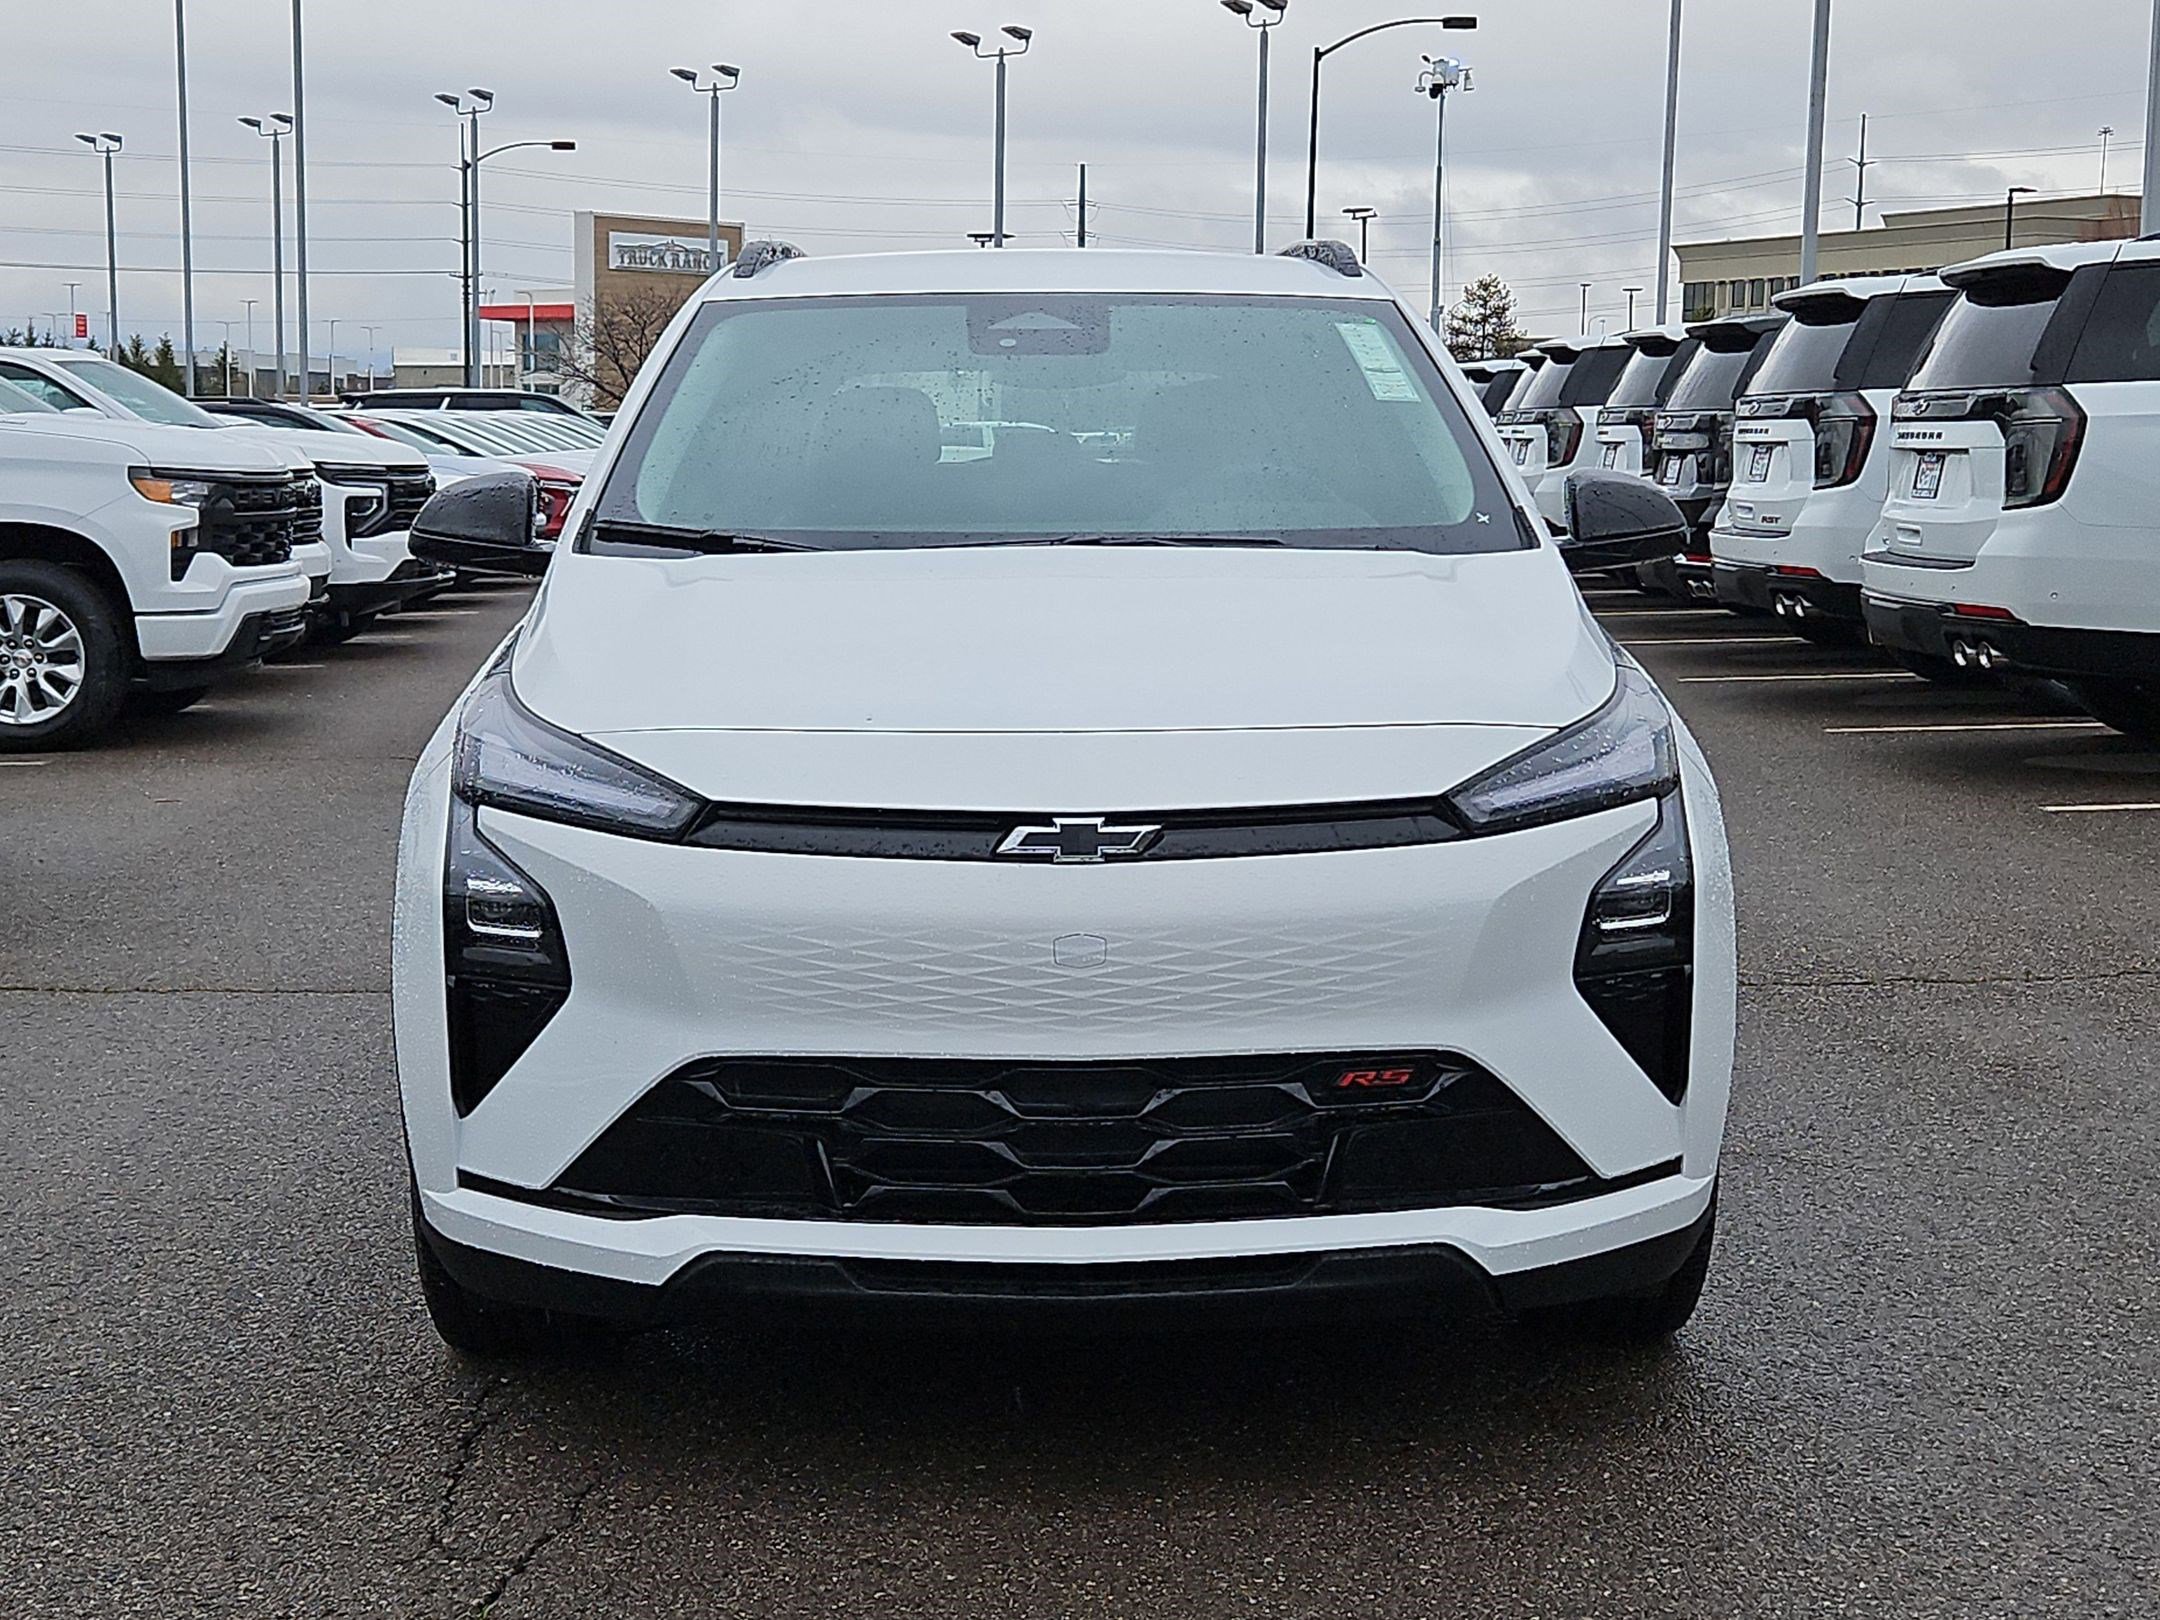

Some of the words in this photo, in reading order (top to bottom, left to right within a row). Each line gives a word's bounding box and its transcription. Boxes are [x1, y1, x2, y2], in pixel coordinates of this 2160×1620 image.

[616, 248, 668, 267] TRUCK
[670, 251, 721, 270] RANC
[1761, 515, 1782, 525] RST
[1337, 1068, 1415, 1089] RS
